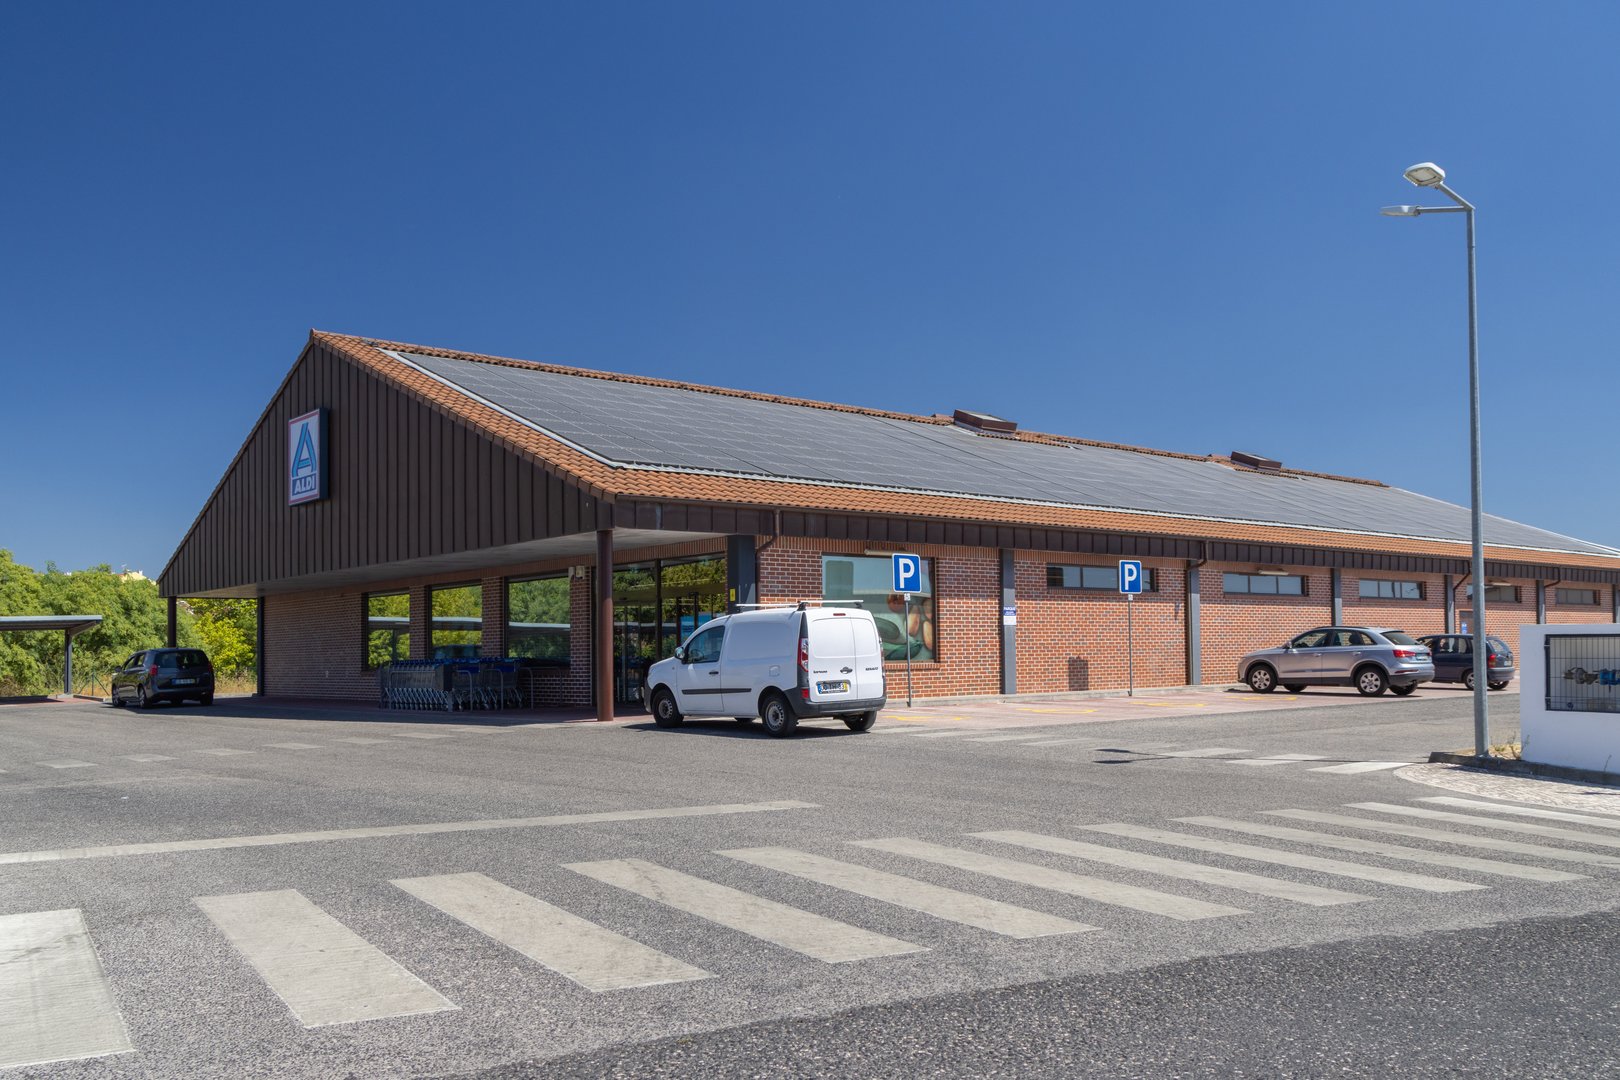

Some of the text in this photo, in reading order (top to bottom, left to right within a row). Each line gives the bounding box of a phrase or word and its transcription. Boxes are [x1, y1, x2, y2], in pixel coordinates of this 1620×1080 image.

[294, 476, 316, 495] ALDI
[899, 557, 915, 589] P
[1124, 563, 1138, 590] P
